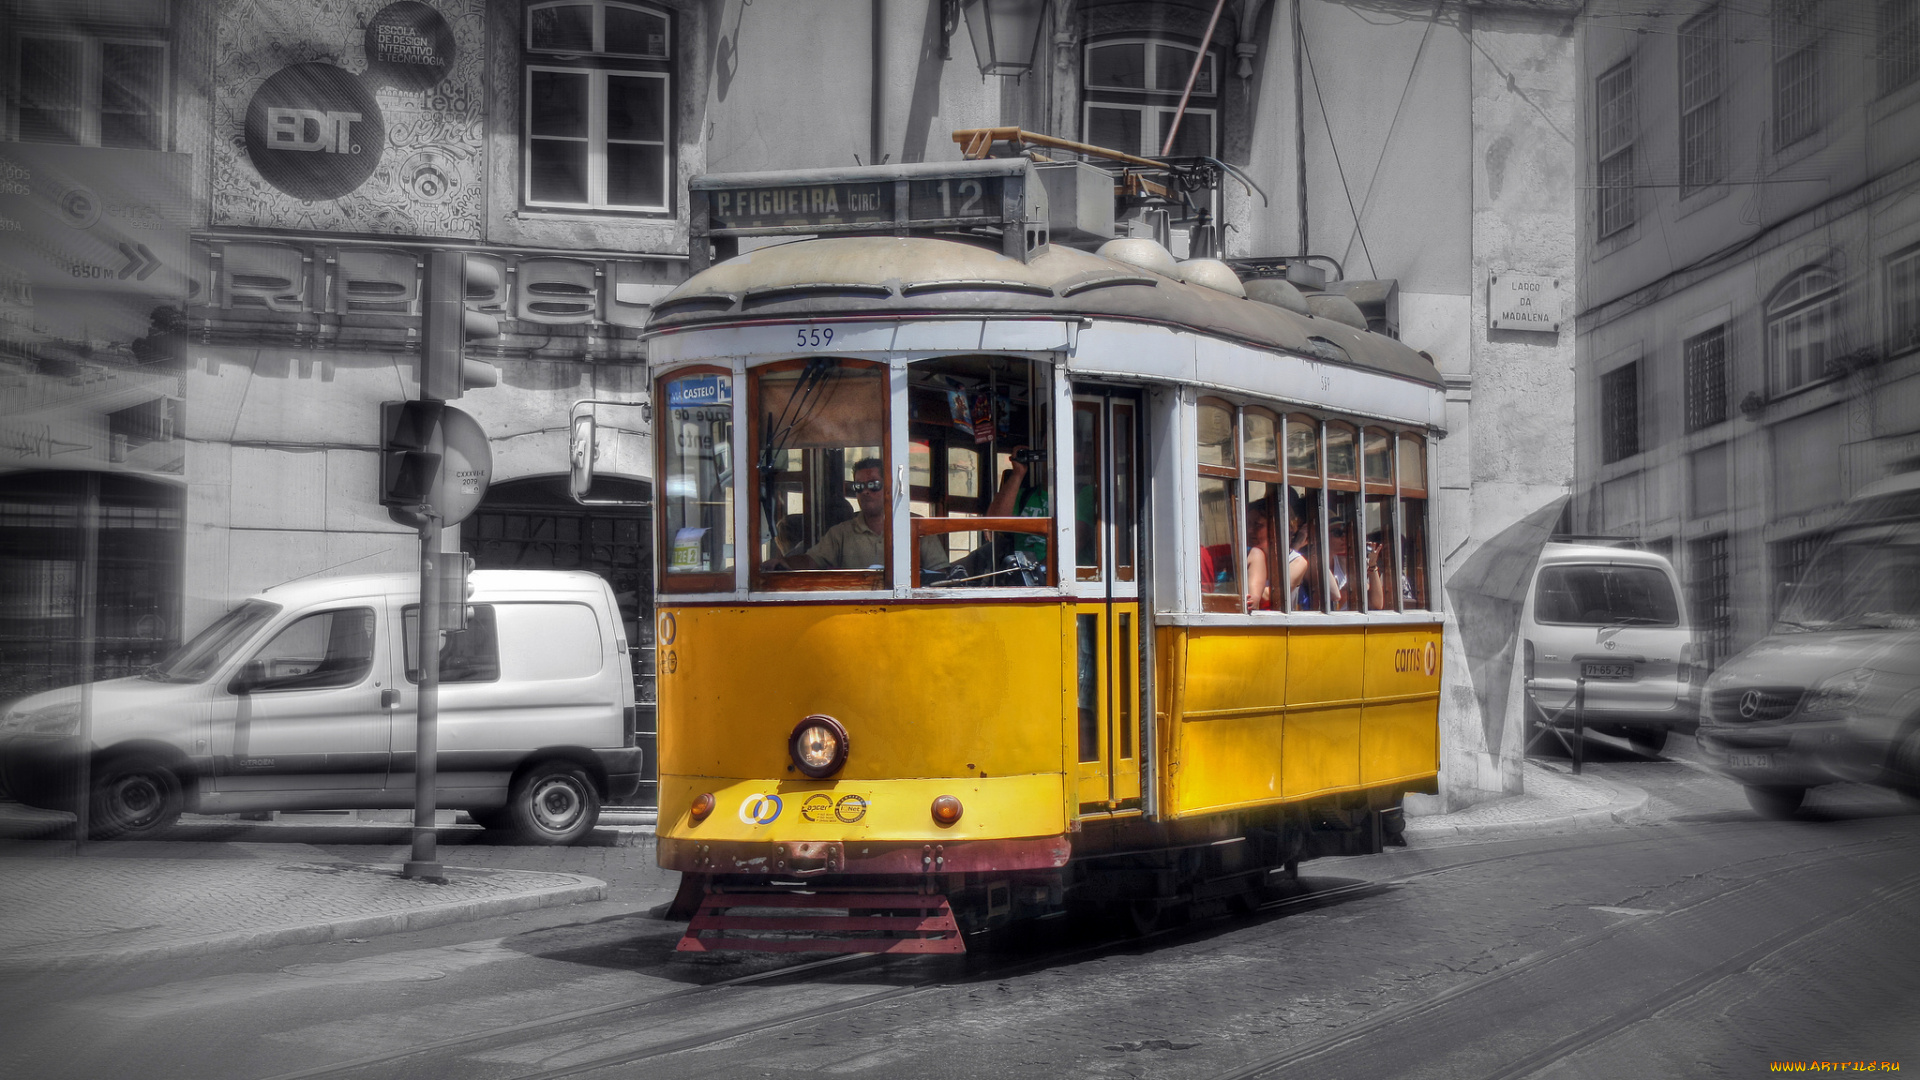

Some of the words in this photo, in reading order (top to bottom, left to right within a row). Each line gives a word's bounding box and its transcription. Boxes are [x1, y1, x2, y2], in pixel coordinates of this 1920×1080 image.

[379, 25, 415, 36] ESCOLA
[378, 35, 392, 43] DE
[393, 36, 428, 46] DESIGN
[378, 44, 433, 55] INTERATIVO
[378, 53, 384, 61] E
[387, 54, 446, 66] TECNOLOGIA
[937, 180, 985, 218] 12
[72, 264, 101, 279] 650
[1511, 282, 1540, 291] LARGO
[1520, 298, 1531, 306] DA
[1503, 311, 1549, 322] MADALENA
[797, 328, 834, 347] 559
[683, 385, 715, 400] CASTELO
[463, 478, 478, 486] 2079
[1395, 637, 1420, 673] carris
